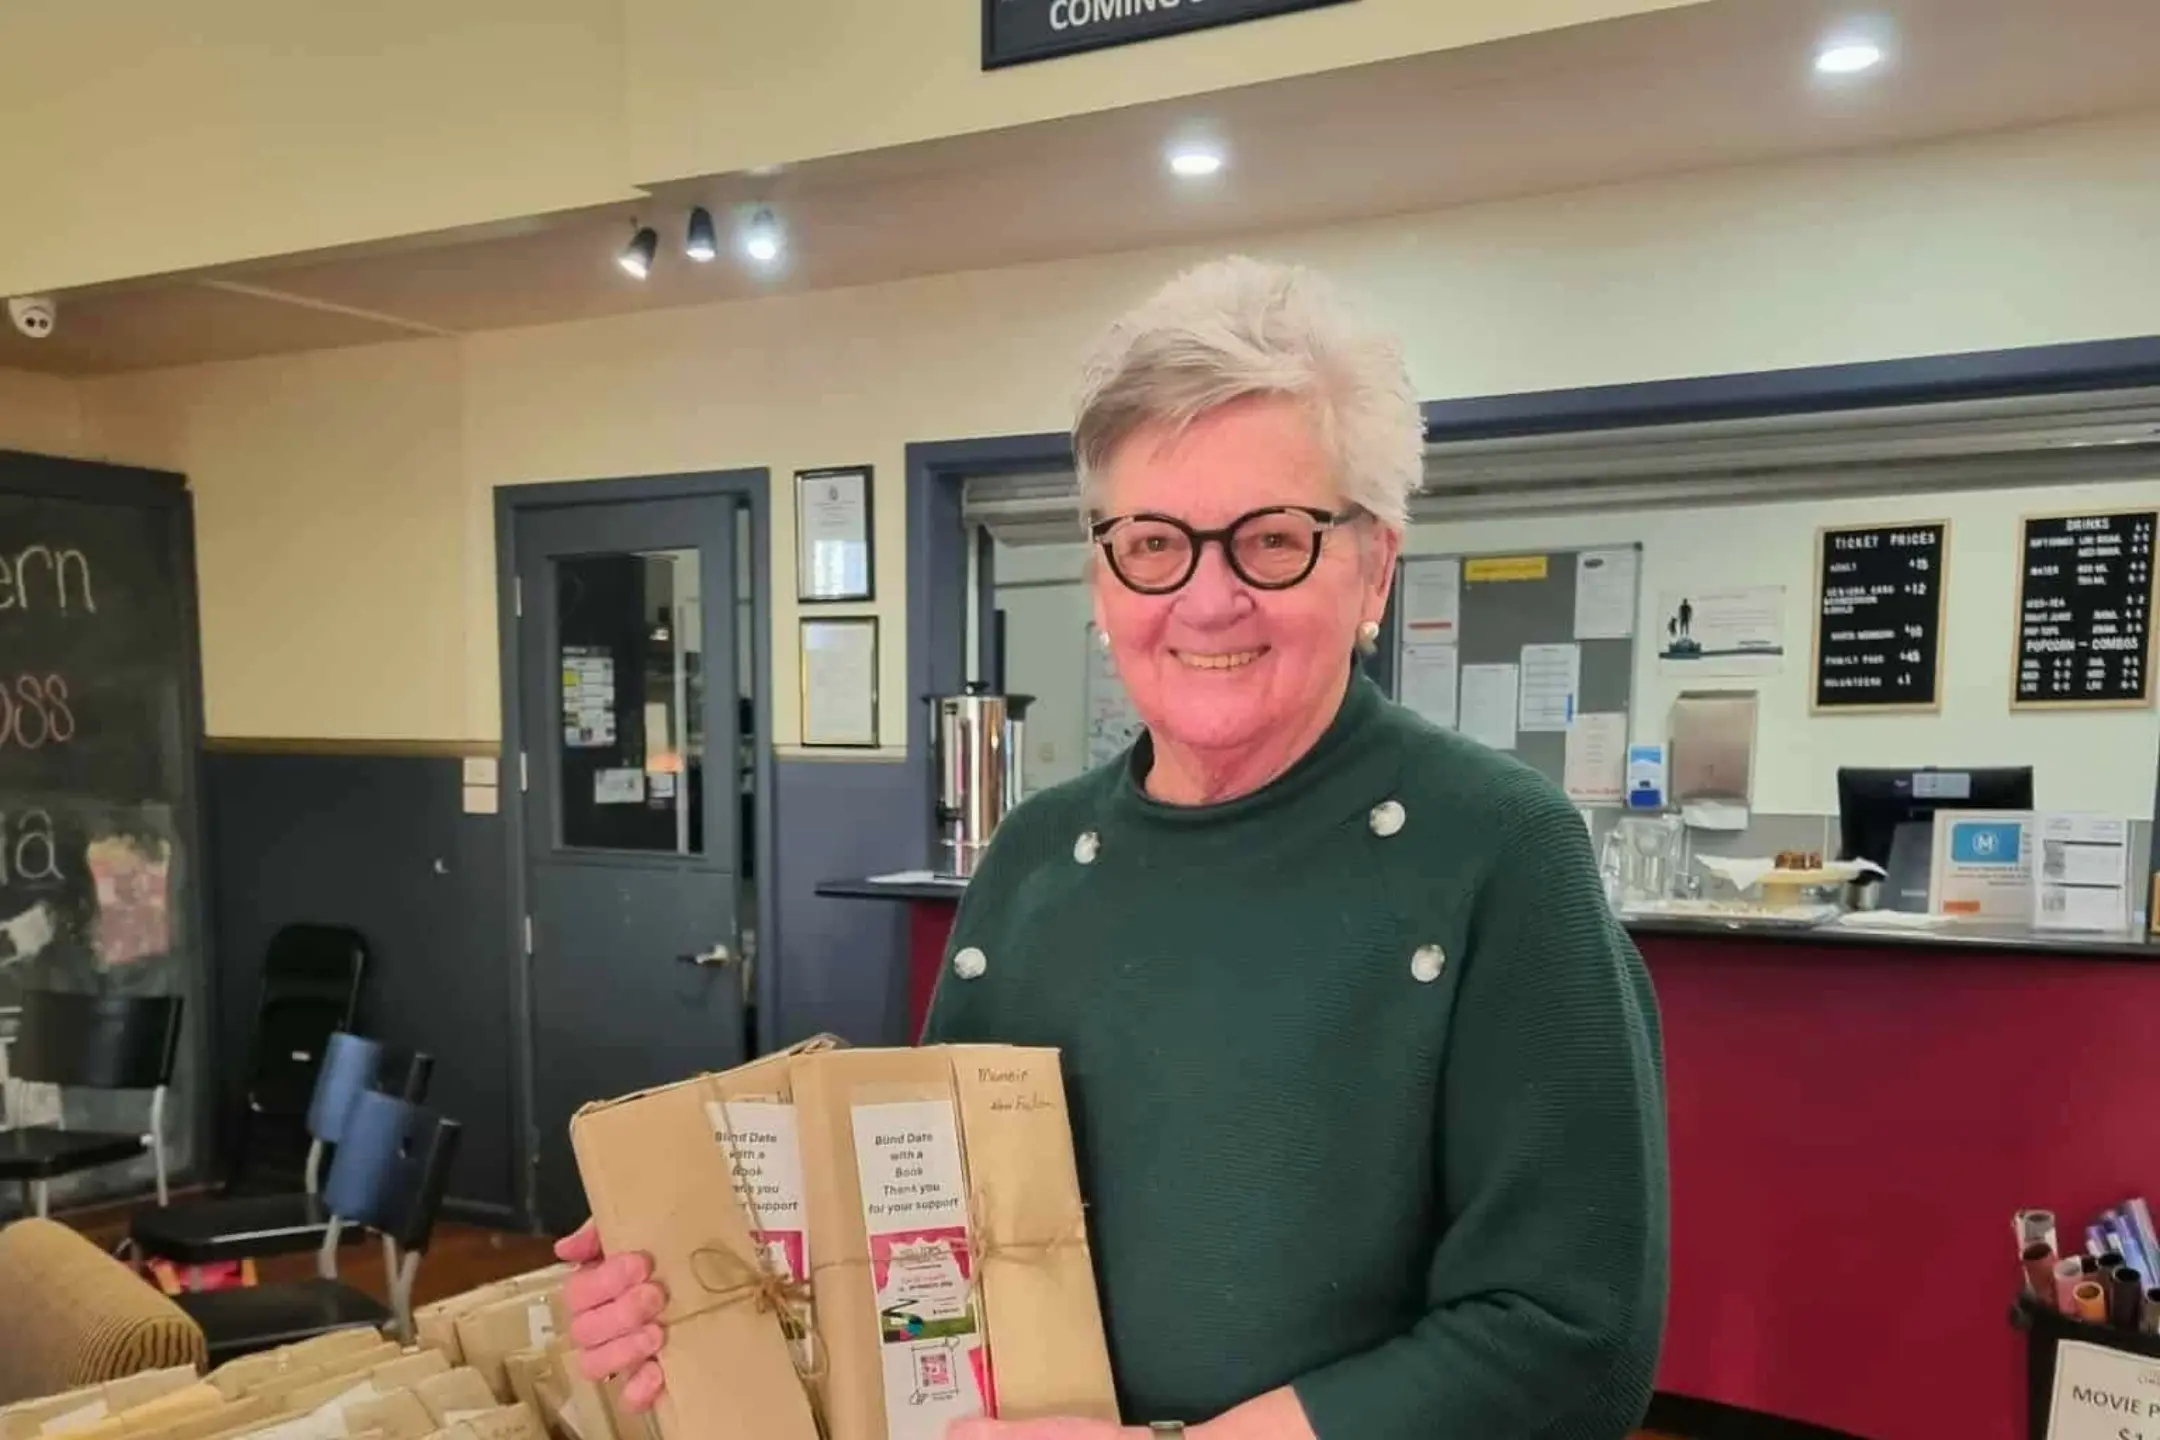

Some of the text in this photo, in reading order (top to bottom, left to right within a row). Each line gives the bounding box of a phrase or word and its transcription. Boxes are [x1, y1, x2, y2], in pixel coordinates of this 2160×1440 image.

[1049, 0, 1180, 31] COMI
[1835, 532, 1935, 549] TICKET PRICES
[2092, 636, 2138, 650] COMBOS
[714, 1131, 777, 1143] Blind Date
[875, 1133, 934, 1146] Blind Date
[890, 1150, 924, 1161] with a
[895, 1167, 924, 1178] Book
[757, 1184, 779, 1194] you
[883, 1184, 940, 1196] Thank you
[868, 1197, 959, 1215] for your support
[2073, 1385, 2141, 1416] MOVIE
